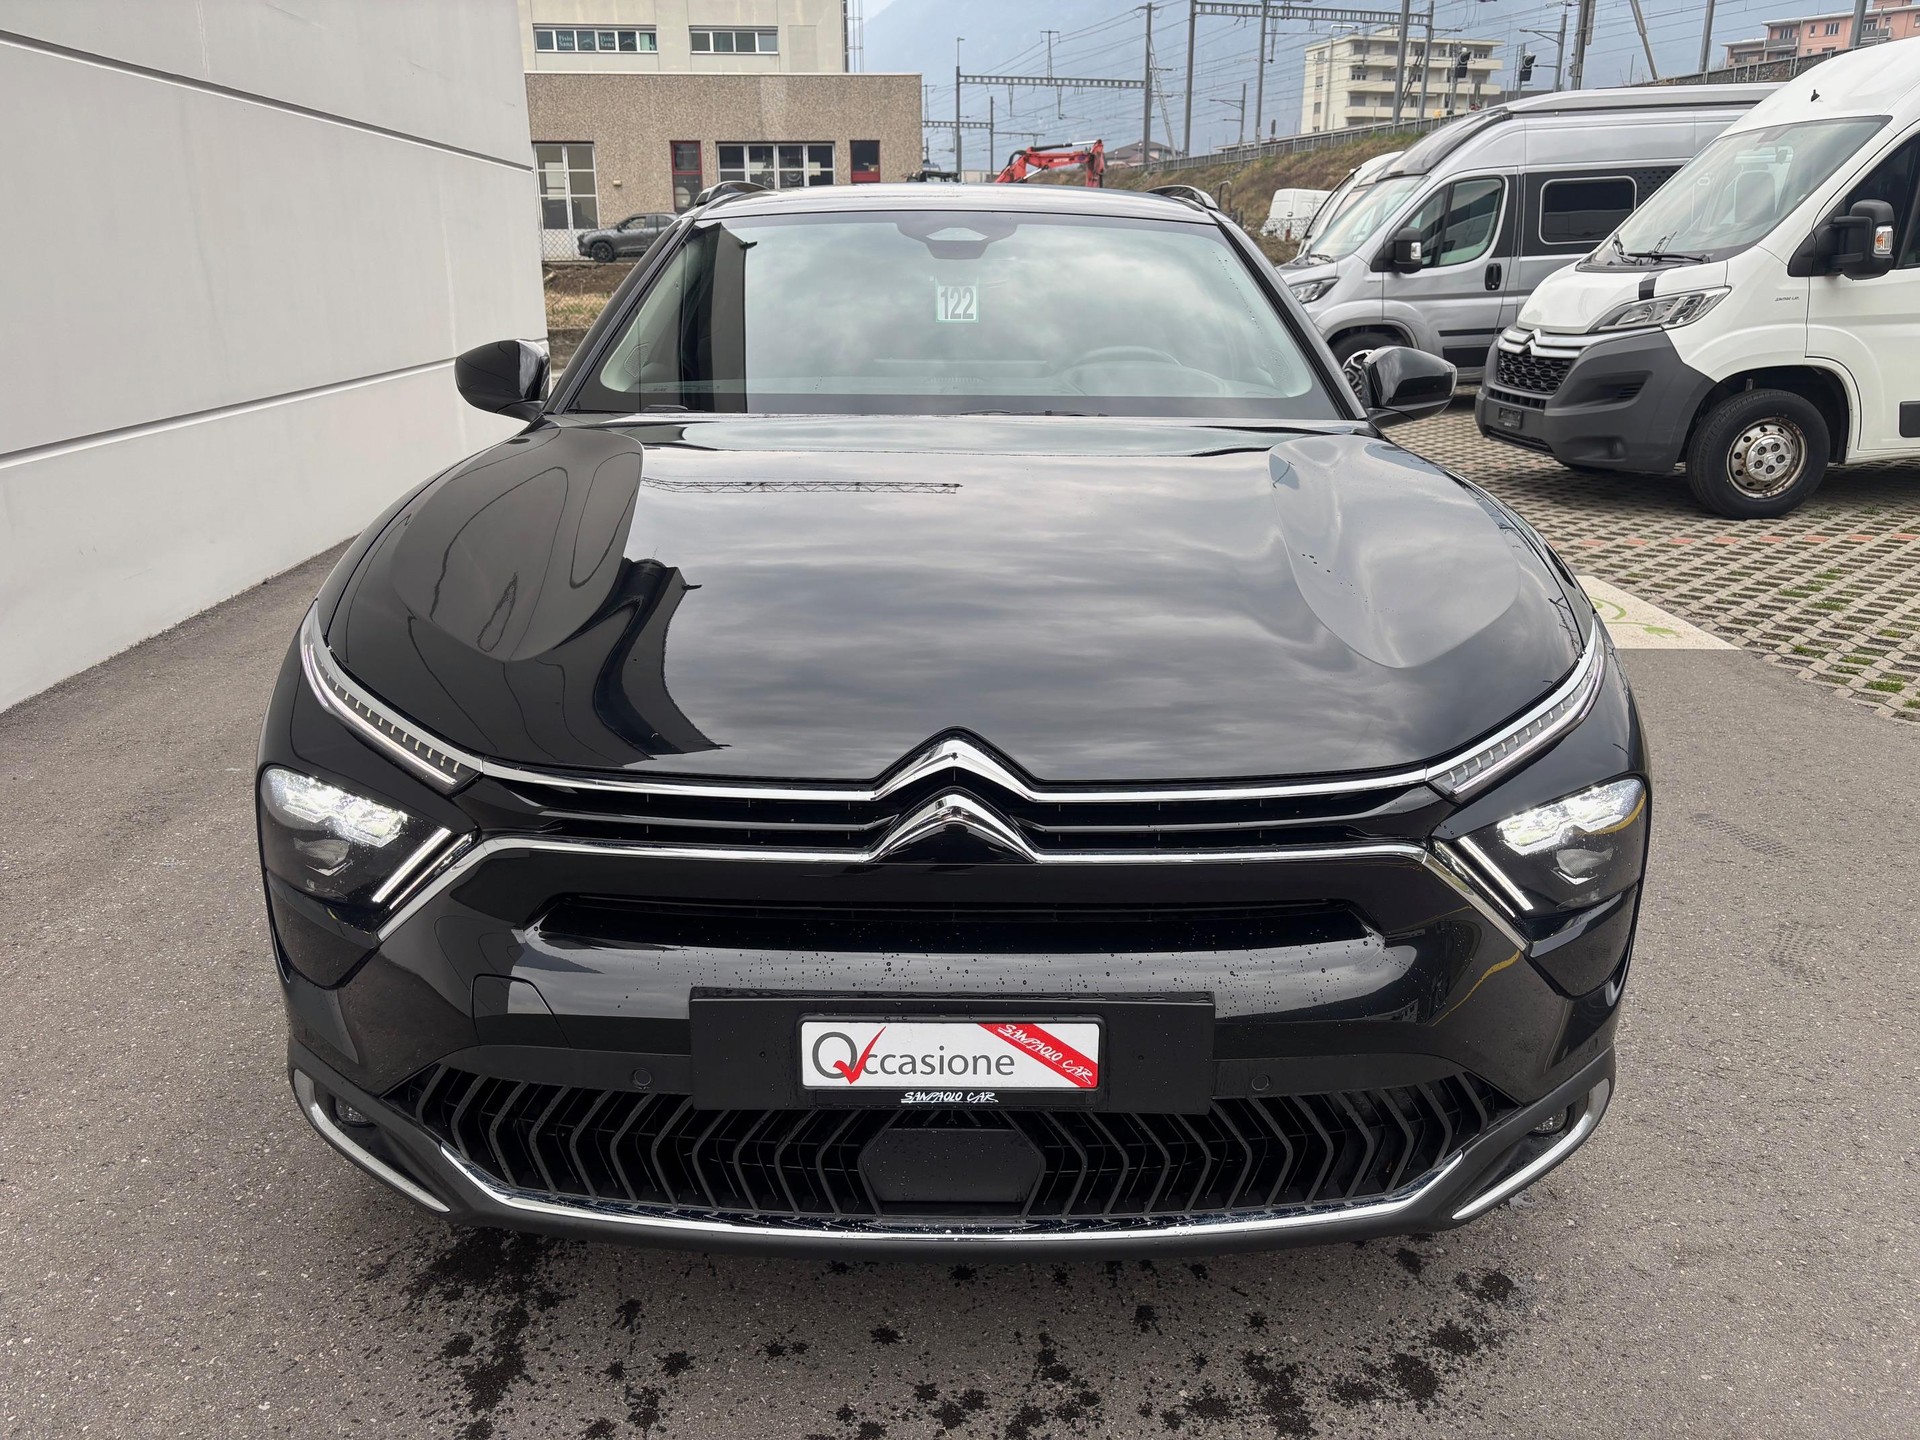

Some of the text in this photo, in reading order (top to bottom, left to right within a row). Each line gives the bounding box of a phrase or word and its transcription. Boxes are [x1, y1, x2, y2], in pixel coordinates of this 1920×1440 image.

[940, 287, 974, 320] 122
[998, 1024, 1093, 1085] SANPAOLO CAR
[901, 1091, 999, 1104] SANPAOLO CAR
